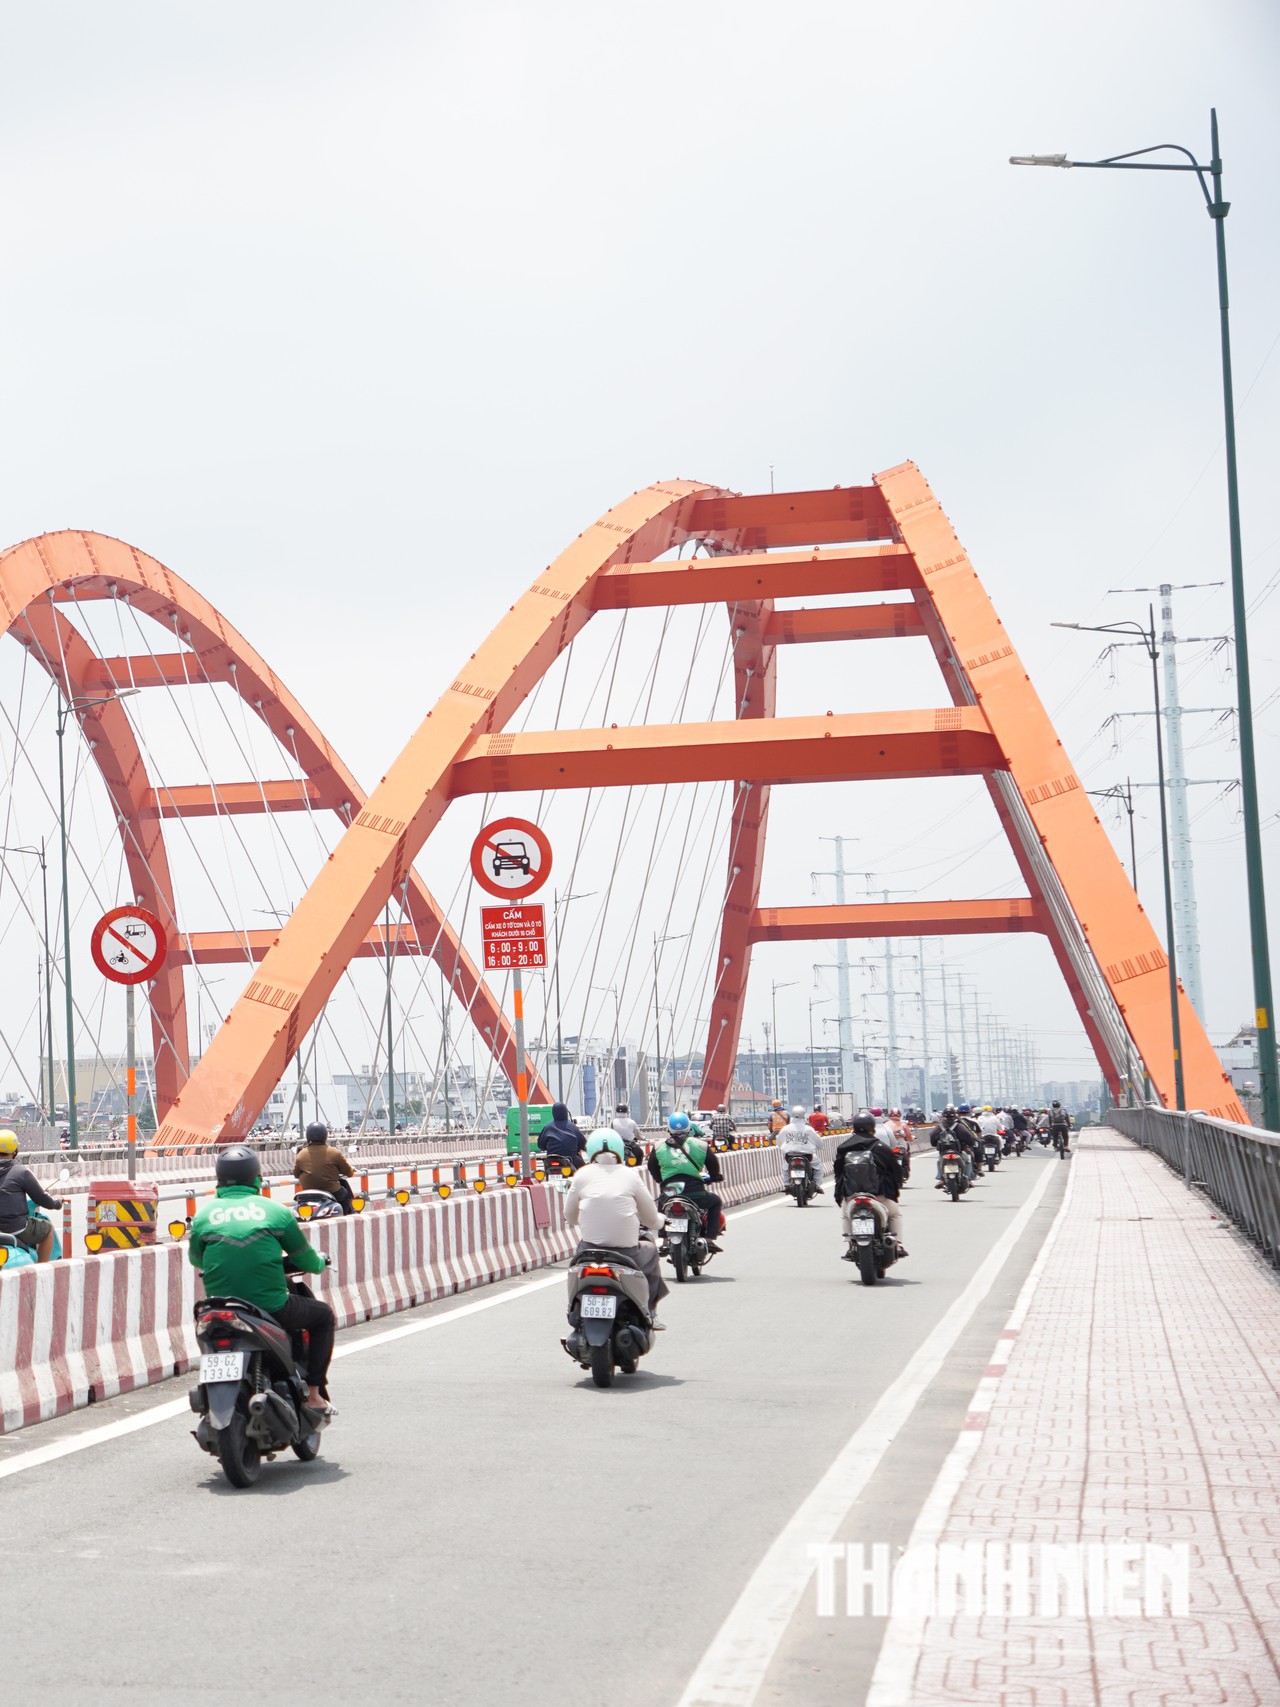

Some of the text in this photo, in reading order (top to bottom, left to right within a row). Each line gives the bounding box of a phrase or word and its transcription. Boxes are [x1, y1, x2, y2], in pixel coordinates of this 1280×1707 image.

[503, 908, 522, 920] CẤM
[208, 1202, 266, 1225] Grab
[587, 1297, 611, 1306] 50-AF
[584, 1307, 613, 1317] 609.82
[207, 1355, 236, 1368] 59-G2
[203, 1367, 239, 1380] 133.43
